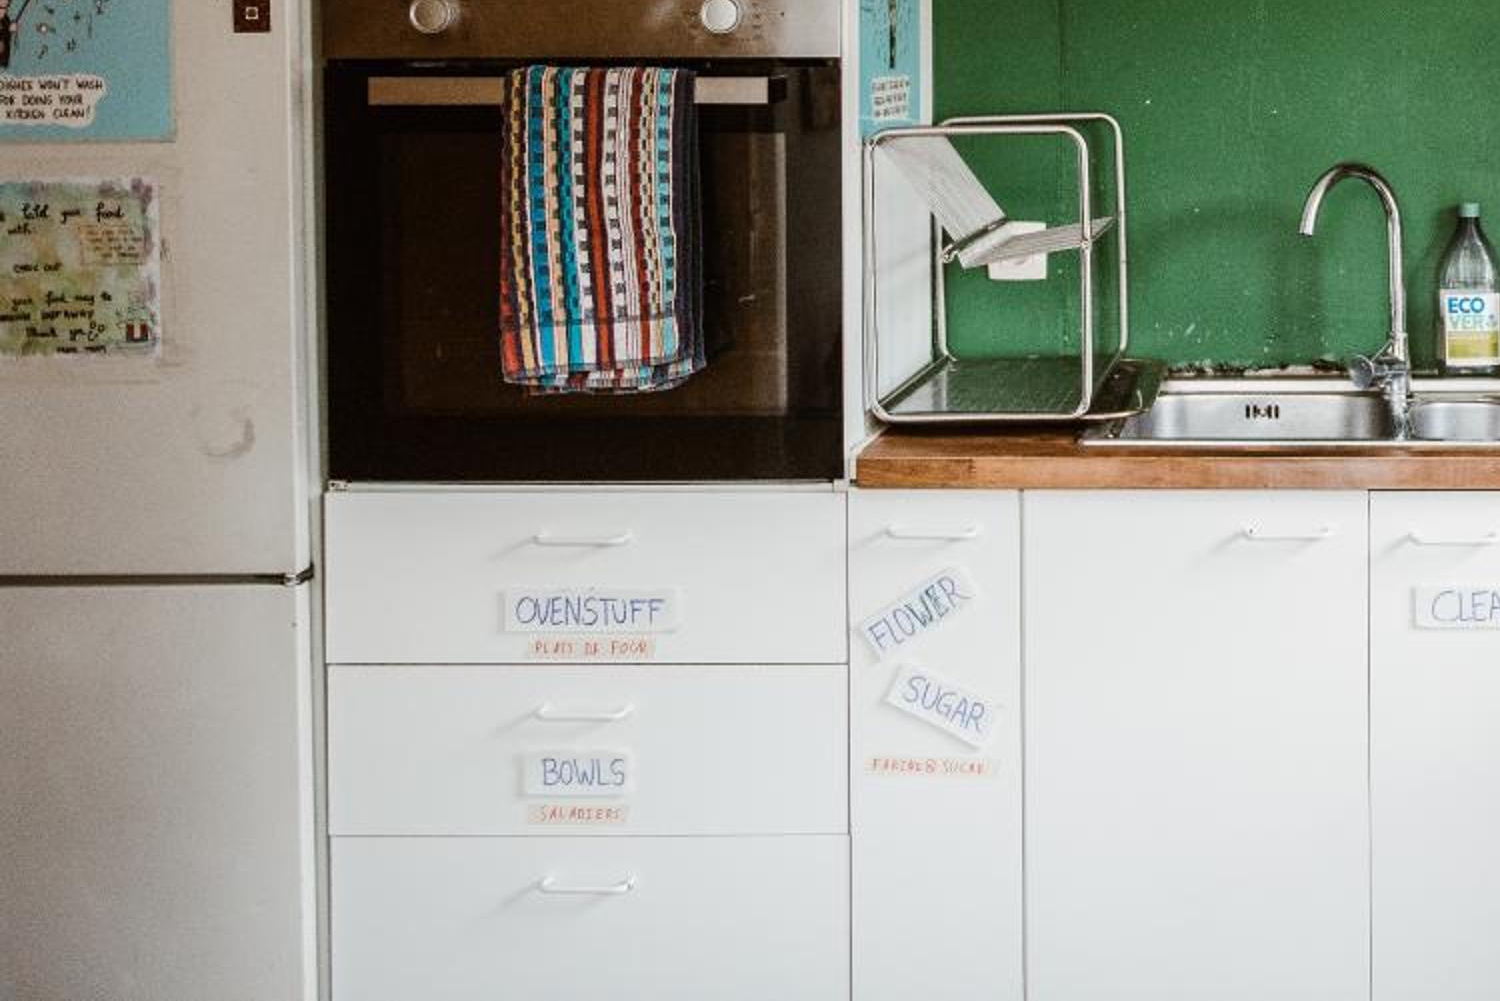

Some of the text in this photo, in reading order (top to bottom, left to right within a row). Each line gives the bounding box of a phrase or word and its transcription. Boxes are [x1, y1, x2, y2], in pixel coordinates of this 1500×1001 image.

[1447, 296, 1485, 314] ECO
[515, 595, 666, 627] OVENSTUFF
[868, 575, 972, 650] FLOWER
[902, 675, 985, 733] SUGAR
[542, 758, 625, 786] BOWLS
